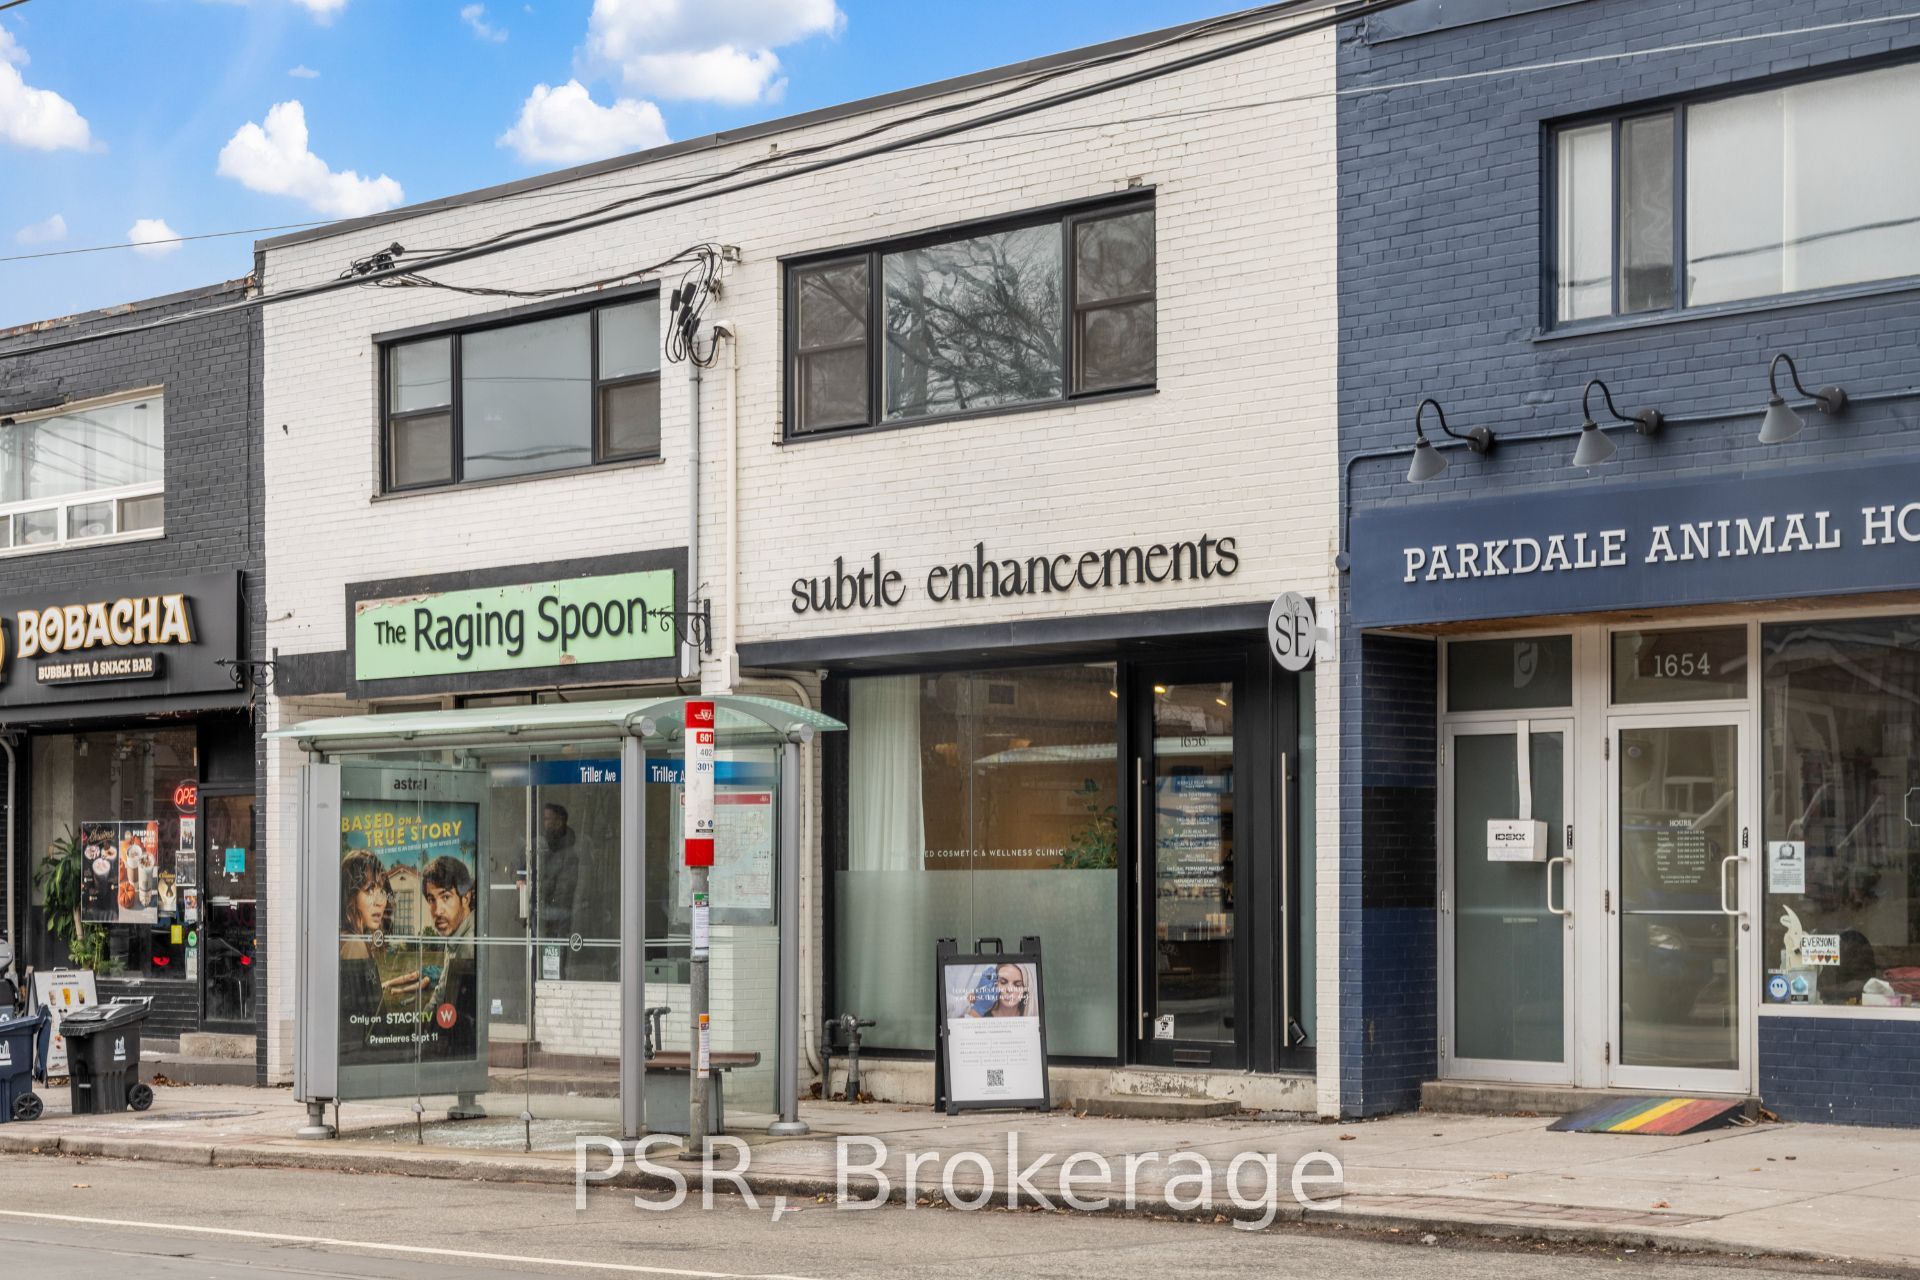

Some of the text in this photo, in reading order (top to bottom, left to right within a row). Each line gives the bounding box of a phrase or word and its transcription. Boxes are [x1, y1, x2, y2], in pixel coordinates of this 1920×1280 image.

[1403, 528, 1627, 583] PARKDALE
[1644, 510, 1841, 564] ANIMAL
[791, 532, 1240, 613] subtle enhancements
[17, 593, 191, 658] BOBACHA
[374, 595, 648, 661] The Raging Spoon
[38, 656, 153, 681] BUBBLE TEA & SNACK BAR
[1654, 652, 1711, 678] 1654
[700, 732, 712, 743] 501
[393, 776, 428, 791] astral
[580, 766, 616, 784] Triller Ave
[652, 765, 678, 784] Triller
[175, 786, 197, 805] OPE
[341, 812, 395, 833] BASED
[365, 827, 405, 848] TRUE
[411, 820, 462, 842] STORY
[1495, 833, 1526, 841] IDEXX
[937, 849, 978, 858] COSMETC
[989, 849, 1033, 857] WELLNESS
[1036, 848, 1064, 857] CLINIC
[1802, 936, 1837, 948] EVERYONE
[350, 1014, 370, 1026] Only
[371, 1016, 381, 1024] on
[441, 1009, 453, 1023] W
[370, 1032, 438, 1044] Premieres Sept 11
